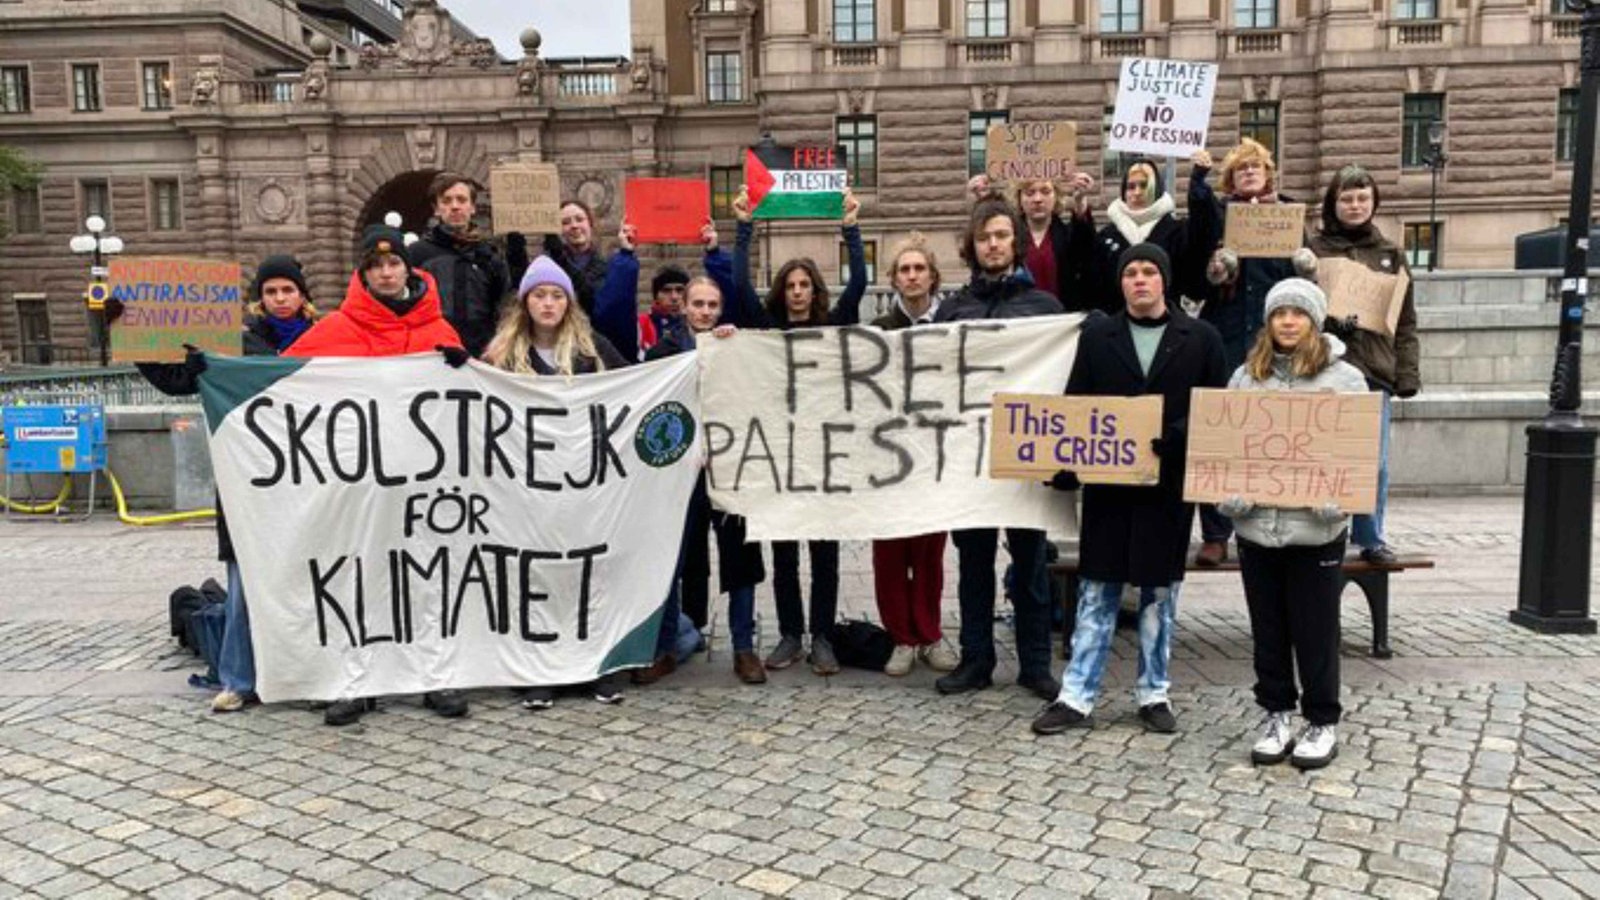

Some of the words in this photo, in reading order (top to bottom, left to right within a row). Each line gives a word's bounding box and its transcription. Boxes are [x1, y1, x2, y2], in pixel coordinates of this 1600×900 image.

[1128, 60, 1208, 81] CLIMATE
[1127, 78, 1204, 98] JUSTICE
[1144, 106, 1174, 123] NO
[1005, 122, 1055, 143] STOP
[1112, 123, 1202, 146] OPRESSION
[793, 146, 835, 169] FREE
[1017, 143, 1040, 155] THE
[501, 172, 551, 190] STAND
[782, 172, 846, 190] PALESTINE
[988, 158, 1071, 182] GENOCIDE
[112, 282, 239, 302] ANTIRASISM
[123, 305, 232, 327] EMINISM
[784, 322, 1006, 414] FREE
[1004, 402, 1066, 436] This
[1089, 407, 1117, 435] is
[1204, 396, 1353, 433] JUSTICE
[244, 389, 631, 491] SKOLSTREJK
[1017, 439, 1036, 463] a
[1054, 437, 1137, 466] CRISIS
[1243, 433, 1315, 461] FOR
[703, 415, 986, 493] PALESTI
[1191, 461, 1354, 499] PALESTINE
[403, 486, 490, 538] FÖR
[308, 543, 608, 647] KLIMATET
